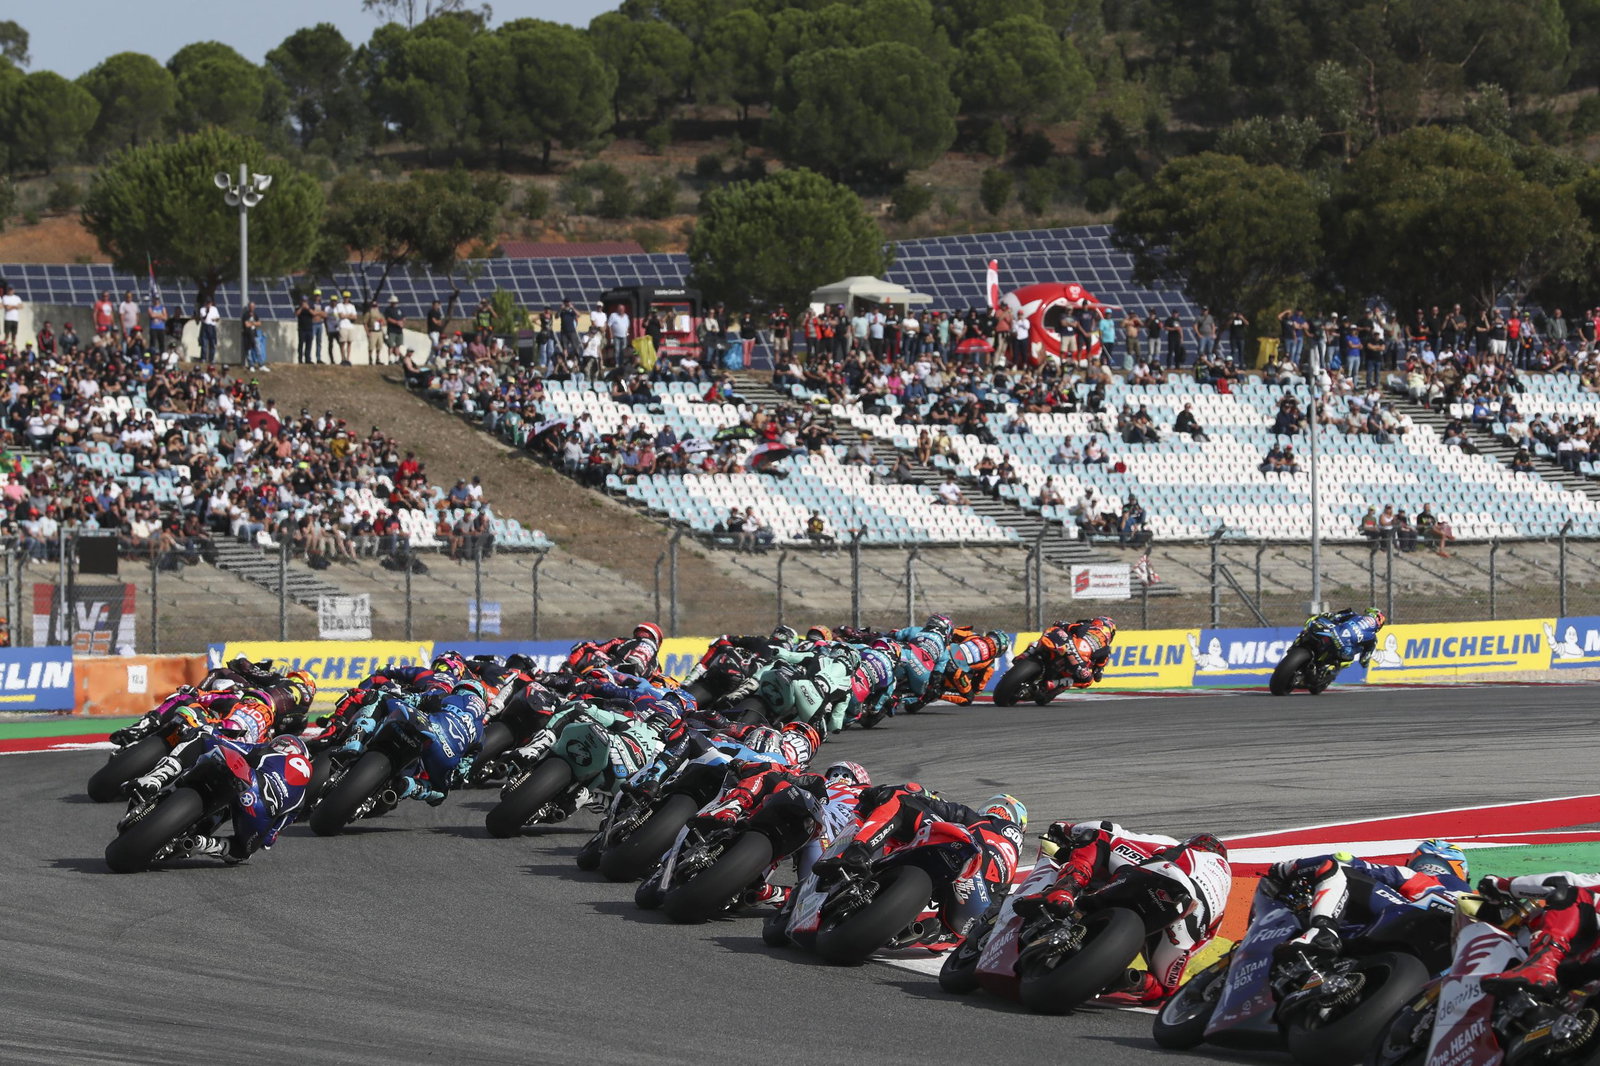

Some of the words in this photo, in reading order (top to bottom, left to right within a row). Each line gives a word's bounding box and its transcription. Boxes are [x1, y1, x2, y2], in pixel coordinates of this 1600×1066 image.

[1109, 644, 1185, 667] HELIN
[1404, 634, 1541, 660] MICHELIN
[1233, 973, 1254, 991] BOX
